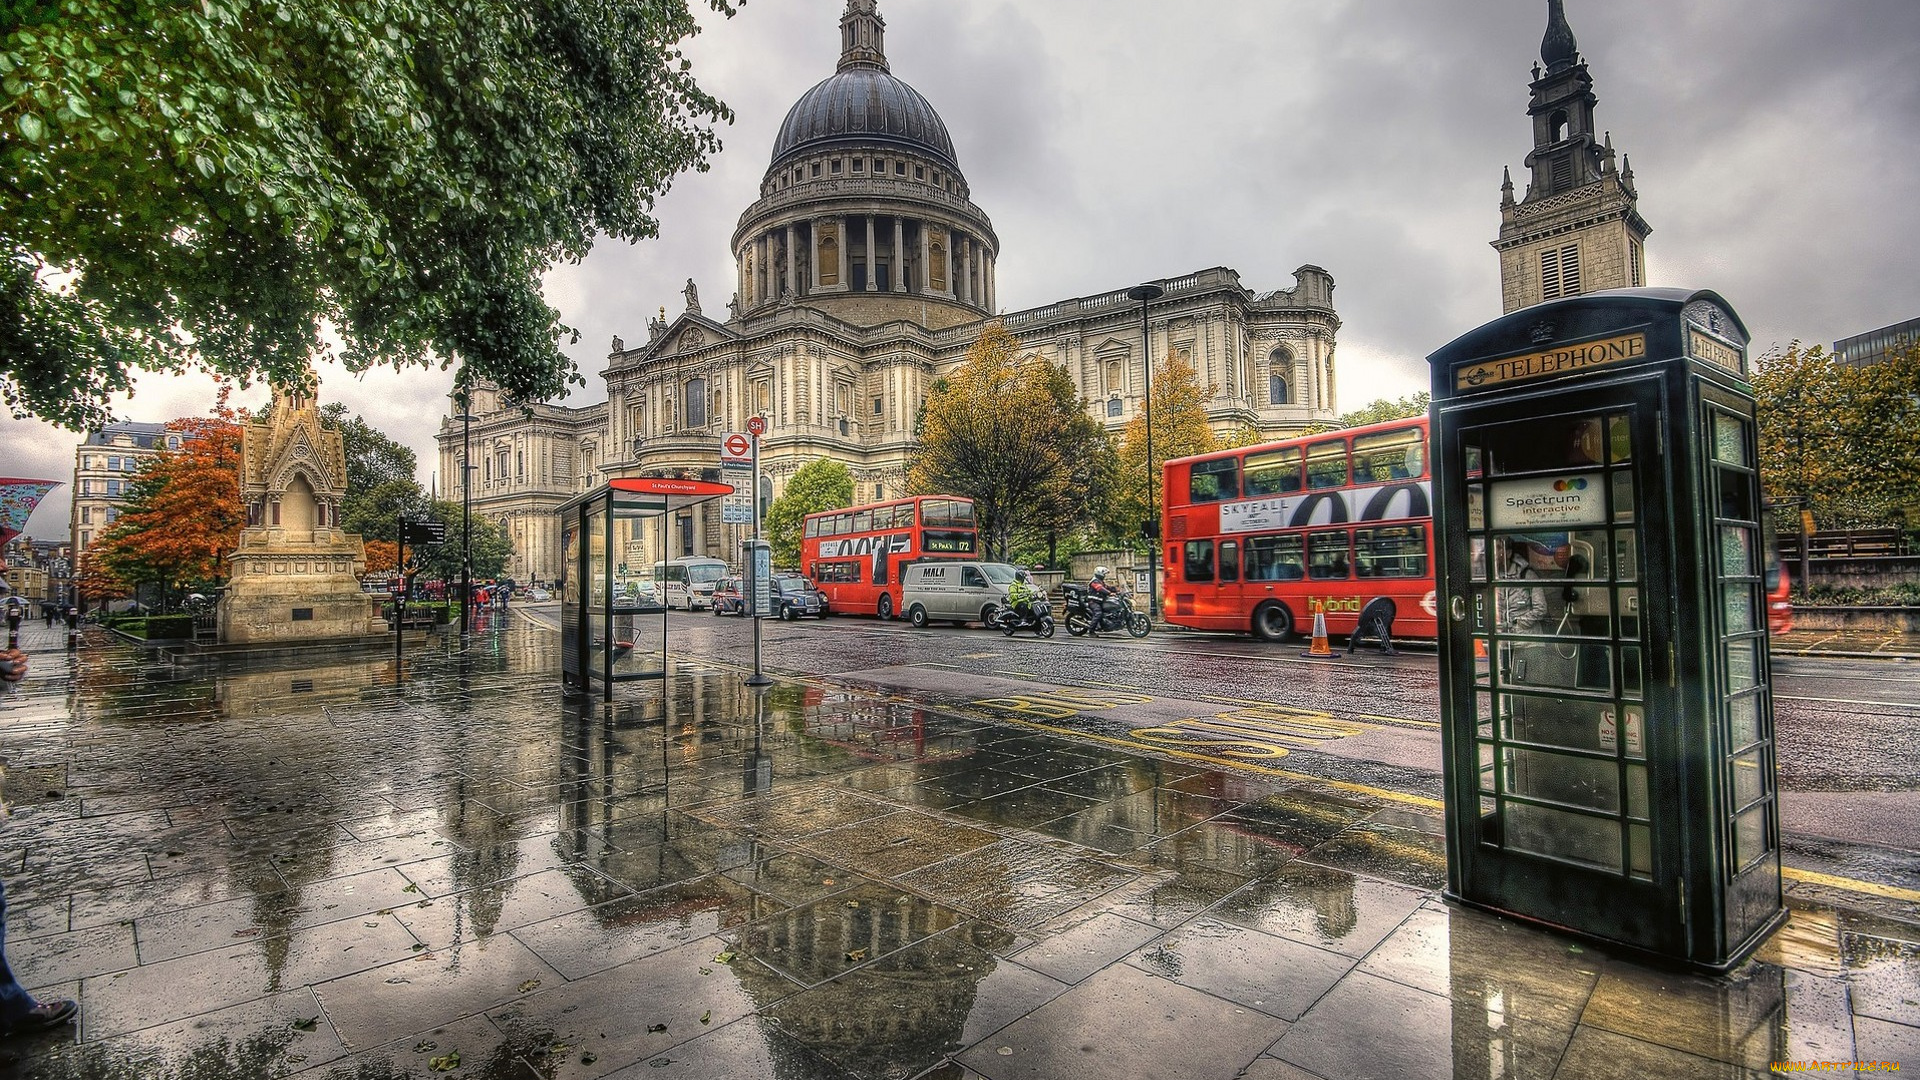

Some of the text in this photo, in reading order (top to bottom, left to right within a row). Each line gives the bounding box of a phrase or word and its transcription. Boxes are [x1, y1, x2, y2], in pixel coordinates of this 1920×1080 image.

[1495, 336, 1645, 380] TELEPHONE
[750, 421, 762, 431] SH
[1222, 500, 1289, 515] SKYFALL
[1506, 494, 1581, 508] Spectrum
[1522, 503, 1581, 515] interactive
[1475, 593, 1484, 628] PULL
